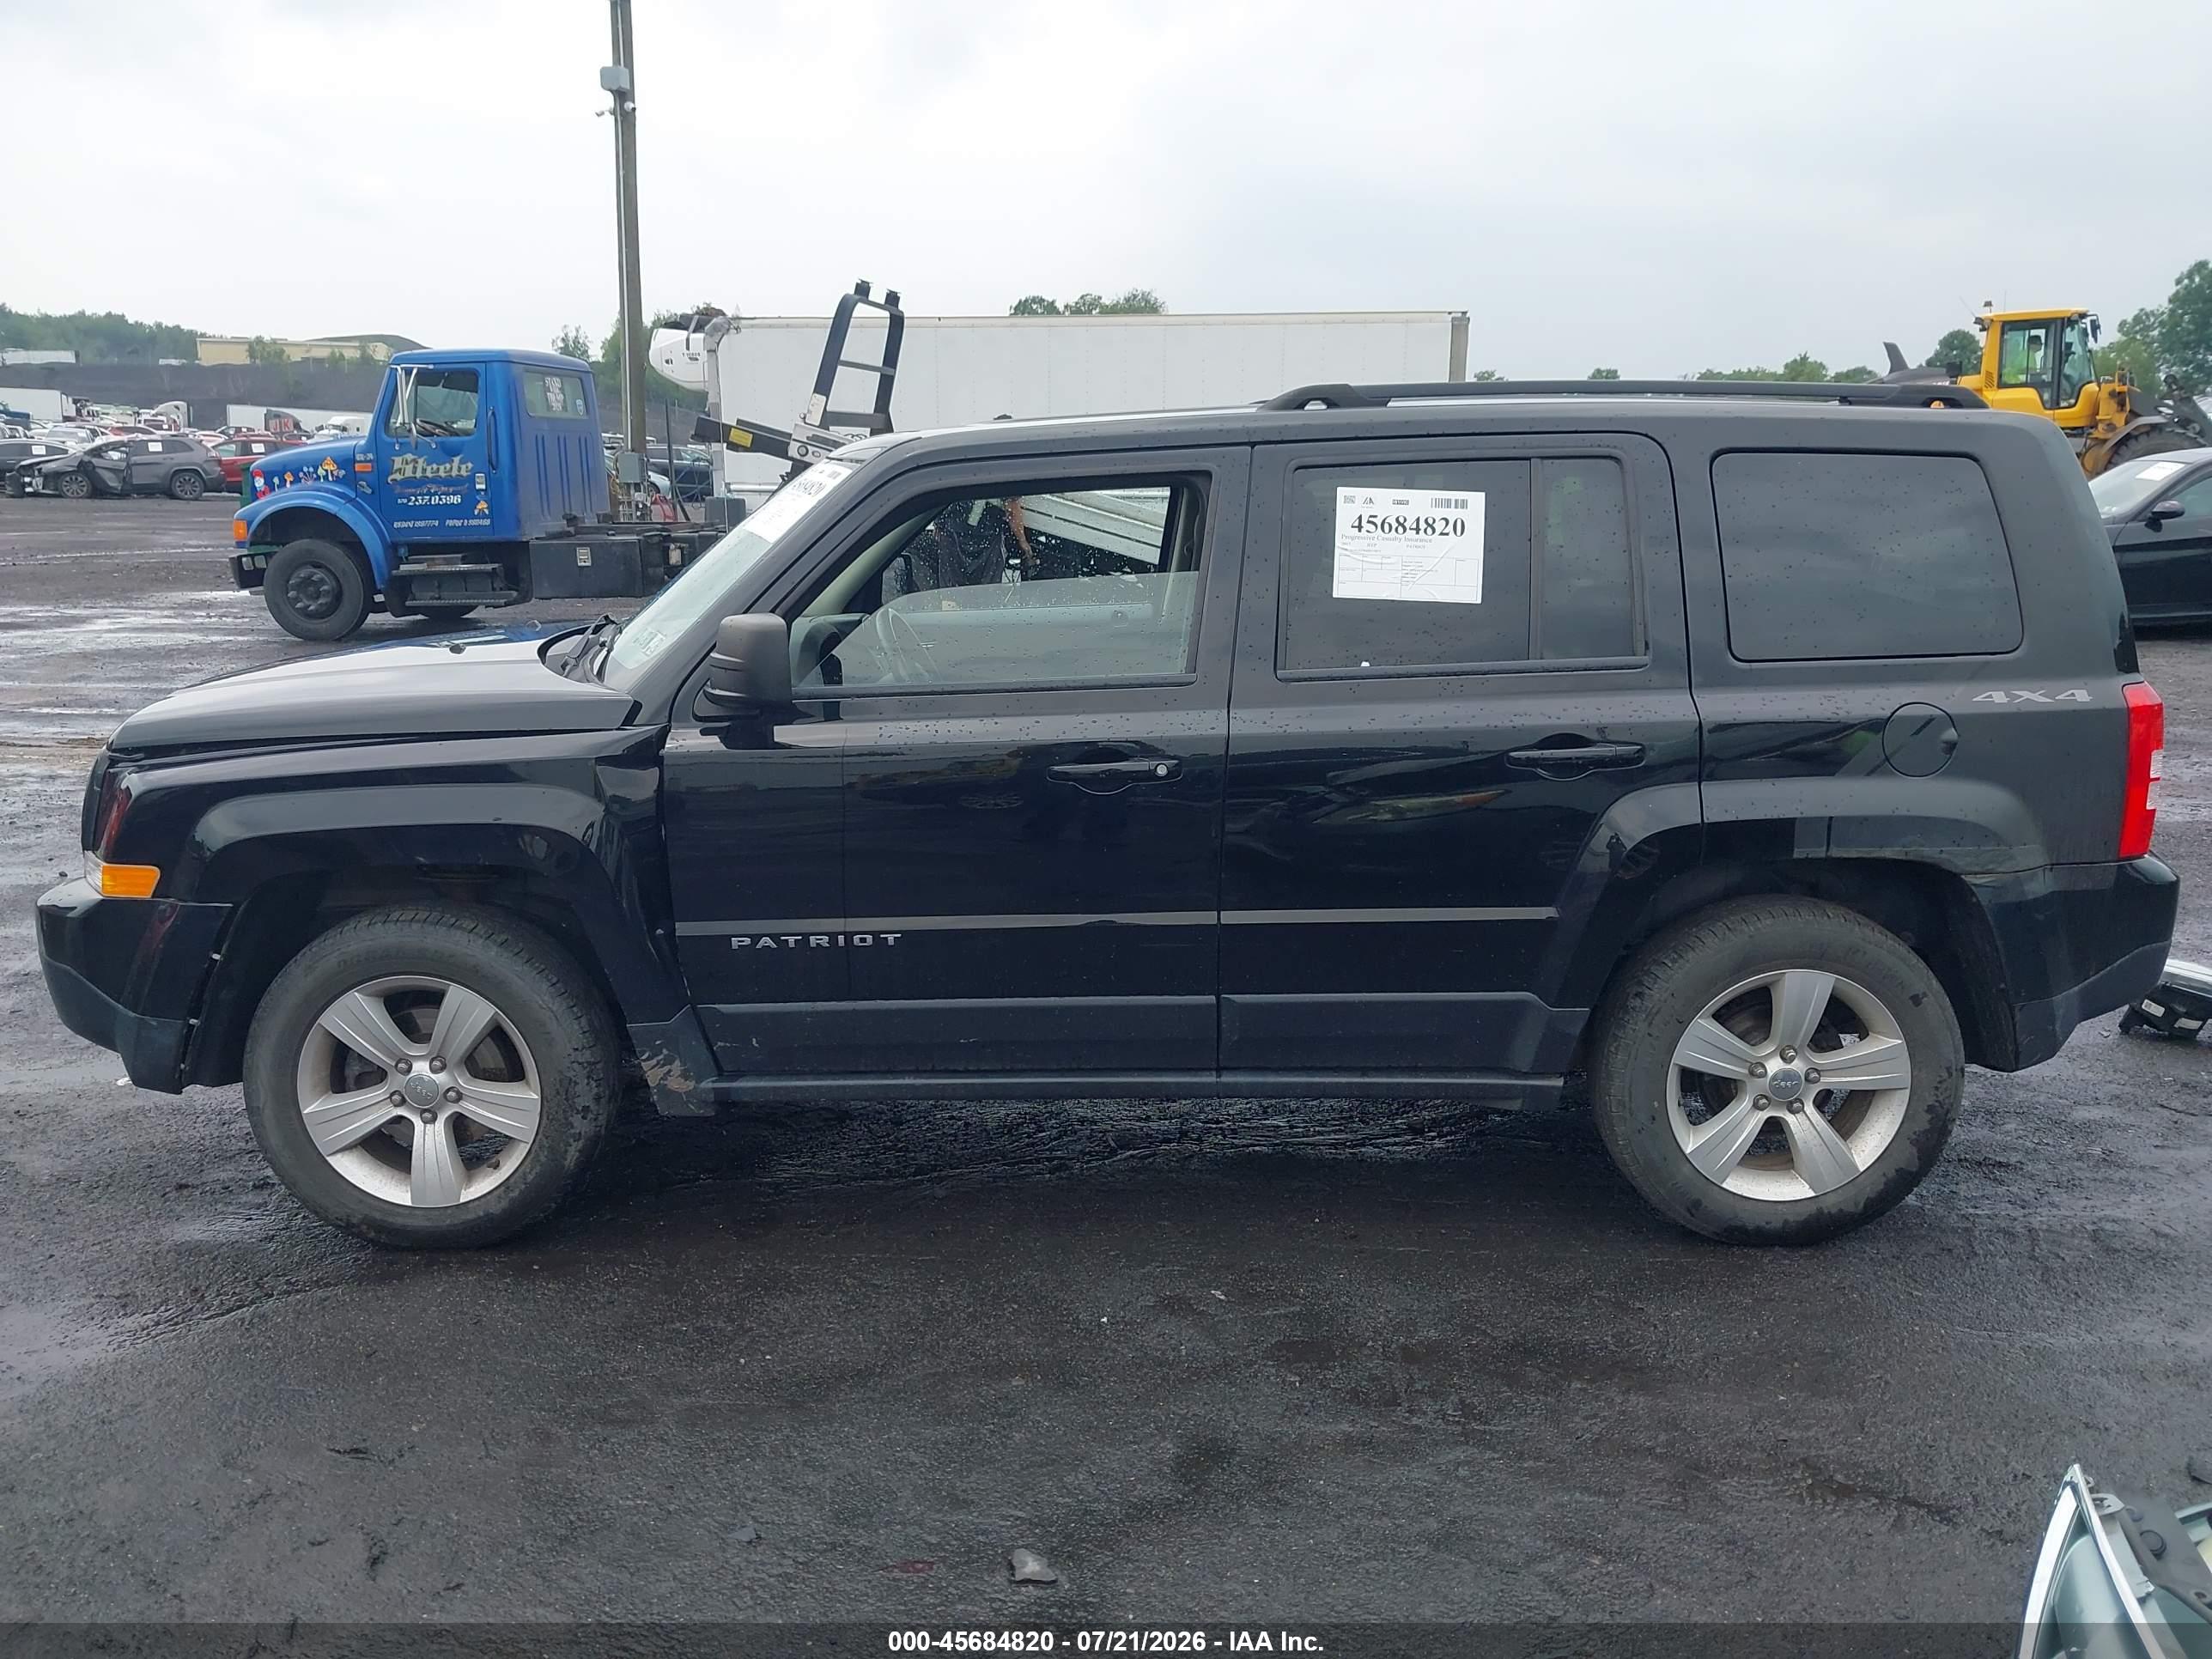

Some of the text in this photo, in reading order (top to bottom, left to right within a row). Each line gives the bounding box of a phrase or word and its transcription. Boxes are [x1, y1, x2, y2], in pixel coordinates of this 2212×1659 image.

[387, 453, 474, 484] Steele
[408, 495, 462, 506] 237.0396
[1351, 514, 1465, 538] 45684820
[1341, 533, 1376, 542] Progressive
[1972, 690, 2093, 703] 4X4
[731, 933, 902, 950] PATRIOT
